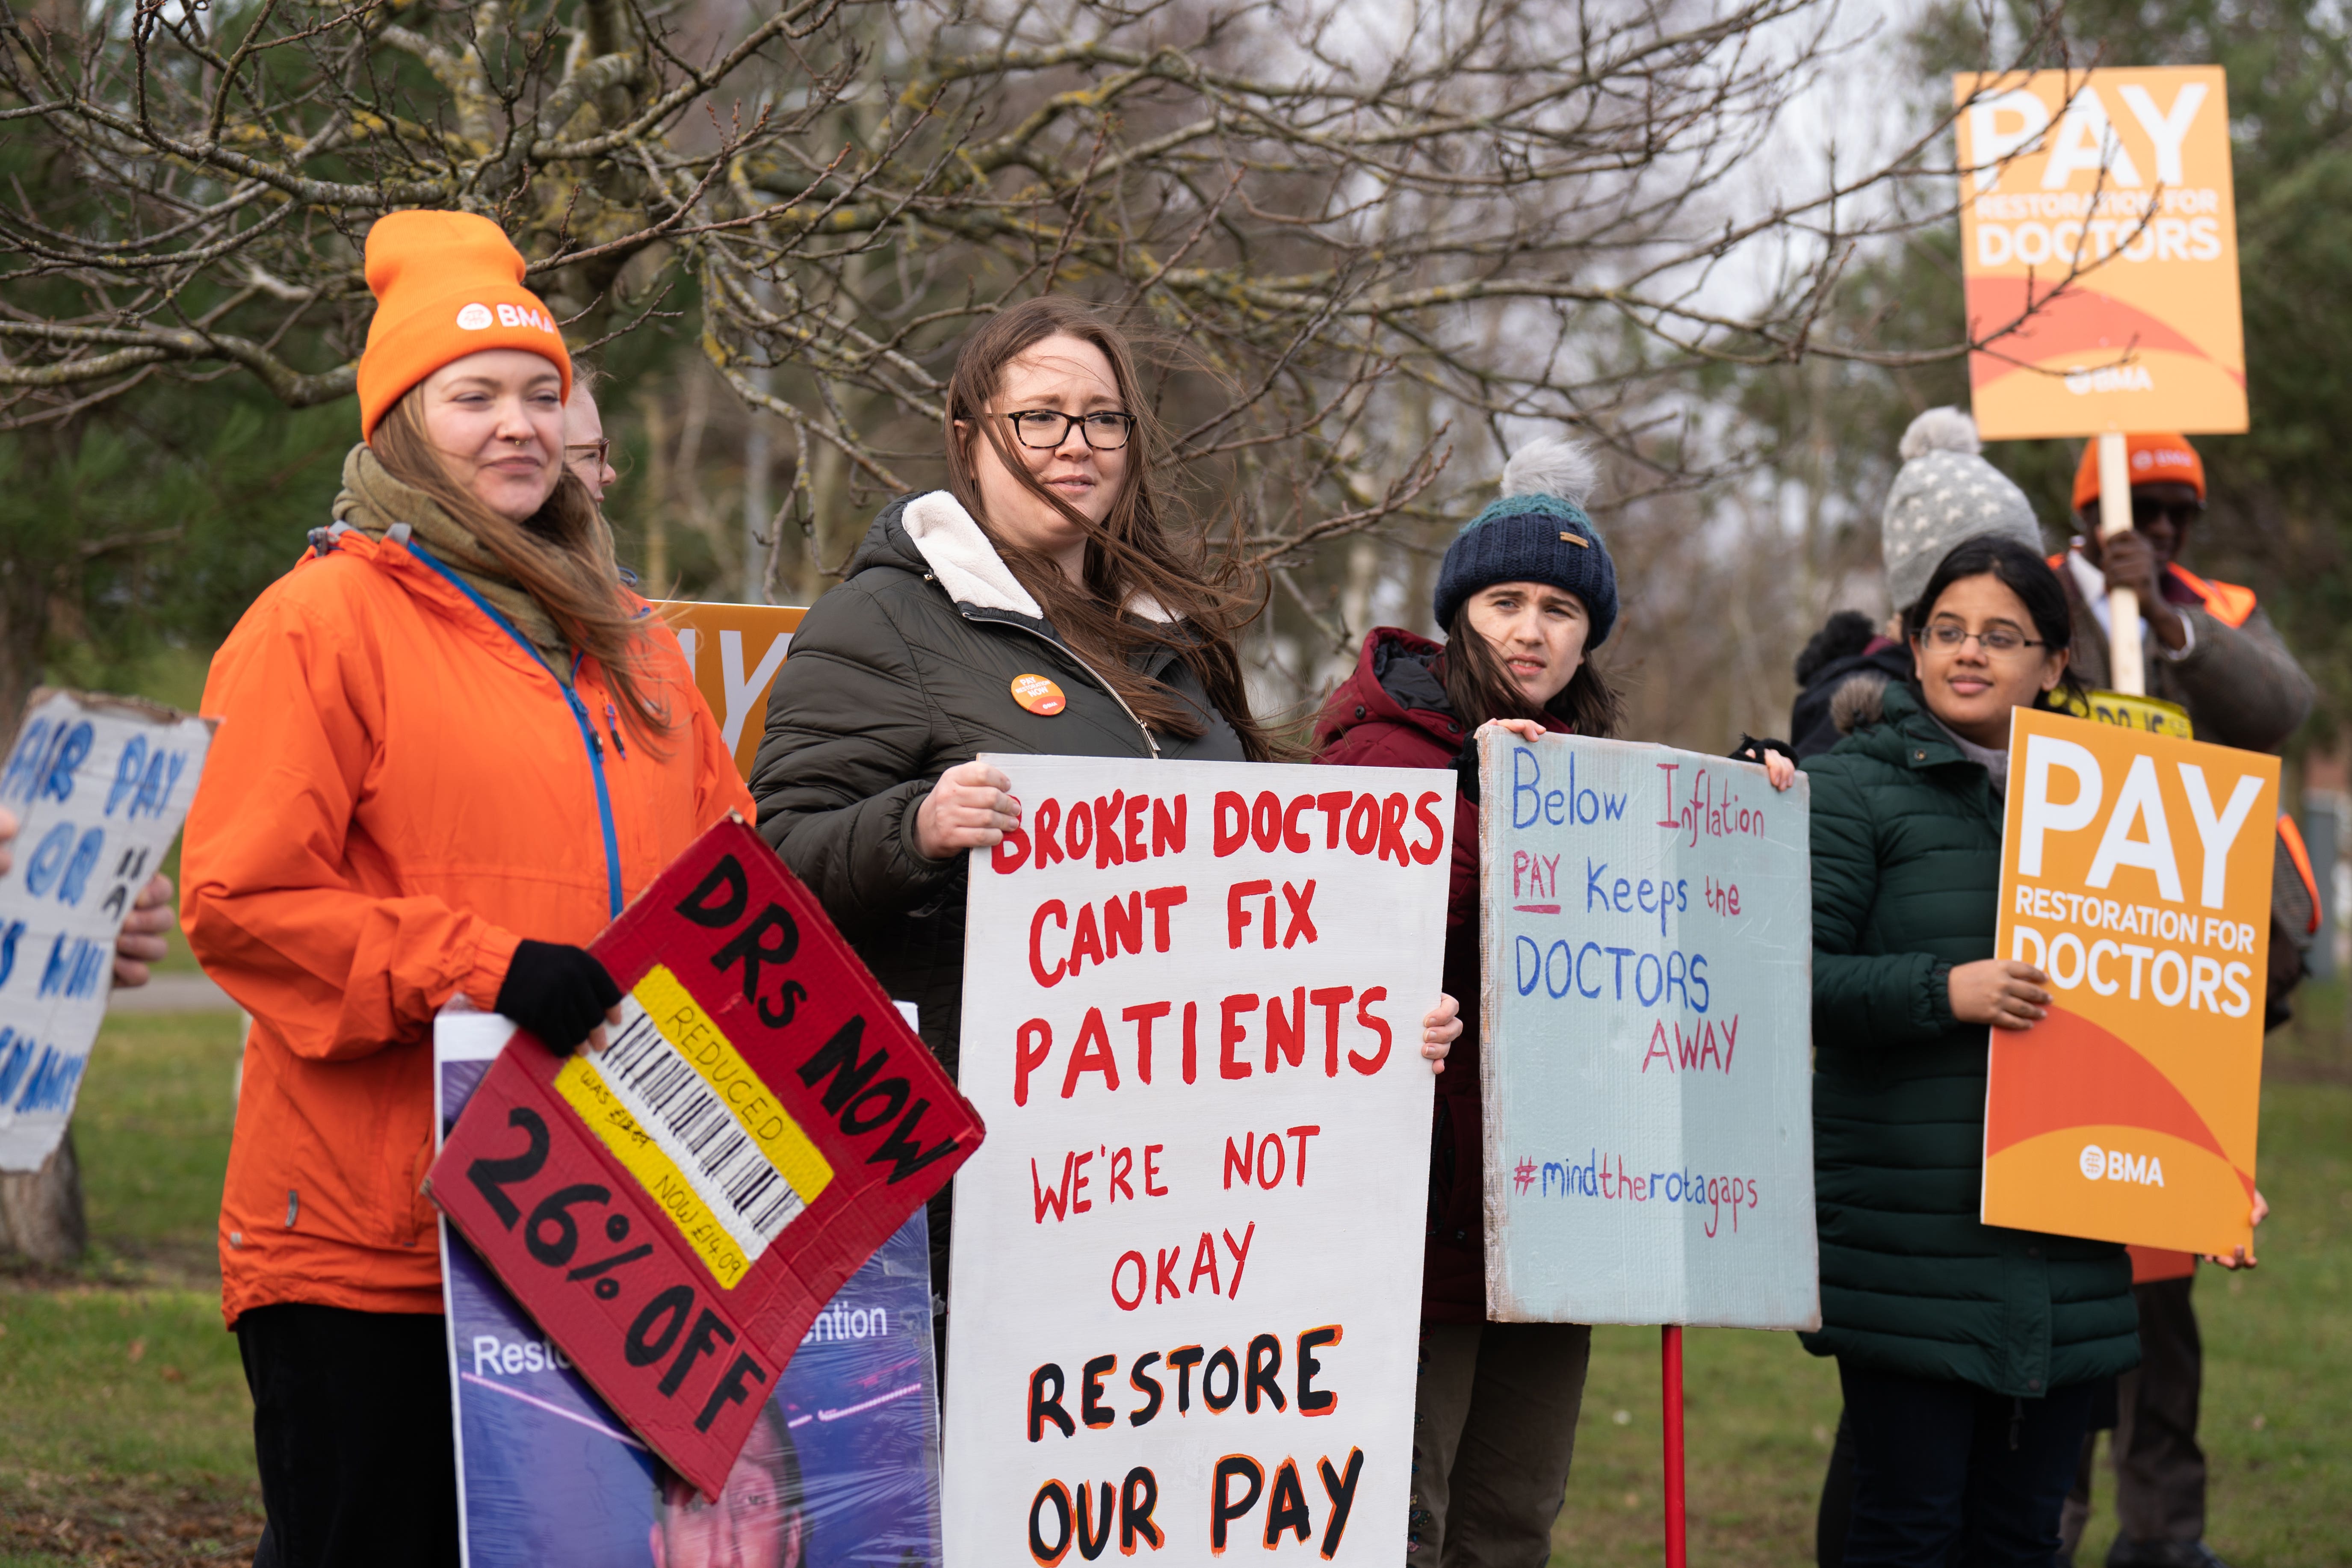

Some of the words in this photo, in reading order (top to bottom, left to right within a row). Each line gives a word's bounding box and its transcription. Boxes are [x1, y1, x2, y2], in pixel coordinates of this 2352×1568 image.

[1969, 83, 2209, 192] PAY
[1975, 191, 2151, 221] RESTORATION
[2164, 188, 2219, 215] FOR
[1977, 217, 2222, 267] DOCTORS
[496, 303, 555, 334] BMA
[1015, 680, 1051, 694] RESTORATION
[1019, 676, 1037, 686] PAY
[1027, 685, 1049, 698] NOW
[104, 732, 187, 819] PAY
[1513, 746, 1627, 830] Below
[1656, 762, 1765, 848] Inflation
[990, 788, 1187, 874] BROKEN
[1213, 790, 1444, 868] DOCTORS
[2018, 734, 2266, 910] PAY
[1029, 885, 1188, 988] CANT
[1513, 849, 1560, 900] PAY
[1587, 856, 1688, 938] Keeps
[1705, 874, 1741, 917] the
[2015, 885, 2198, 945] RESTORATION
[2204, 918, 2255, 954] FOR
[1515, 935, 1710, 1013] DOCTORS
[2012, 924, 2252, 1019] DOCTORS
[665, 1005, 783, 1140] REDUCED
[1013, 986, 1393, 1107] PATIENTS
[1642, 1013, 1739, 1075] AWAY
[795, 1013, 960, 1186] NOW
[580, 1069, 610, 1105] WAS
[653, 1174, 698, 1223] NOW
[691, 1224, 742, 1282] £14.09
[1031, 1144, 1169, 1224] WE'RE
[1223, 1125, 1321, 1190] NOT
[1513, 1147, 1758, 1238] #mindtherotagaps
[2107, 1150, 2164, 1188] BMA
[466, 1107, 653, 1300] 26%
[624, 1285, 767, 1433] OFF
[1111, 1221, 1256, 1311] OKAY
[1027, 1324, 1343, 1442] RESTORE
[1028, 1466, 1165, 1568] OUR
[1209, 1445, 1364, 1561] PAY
